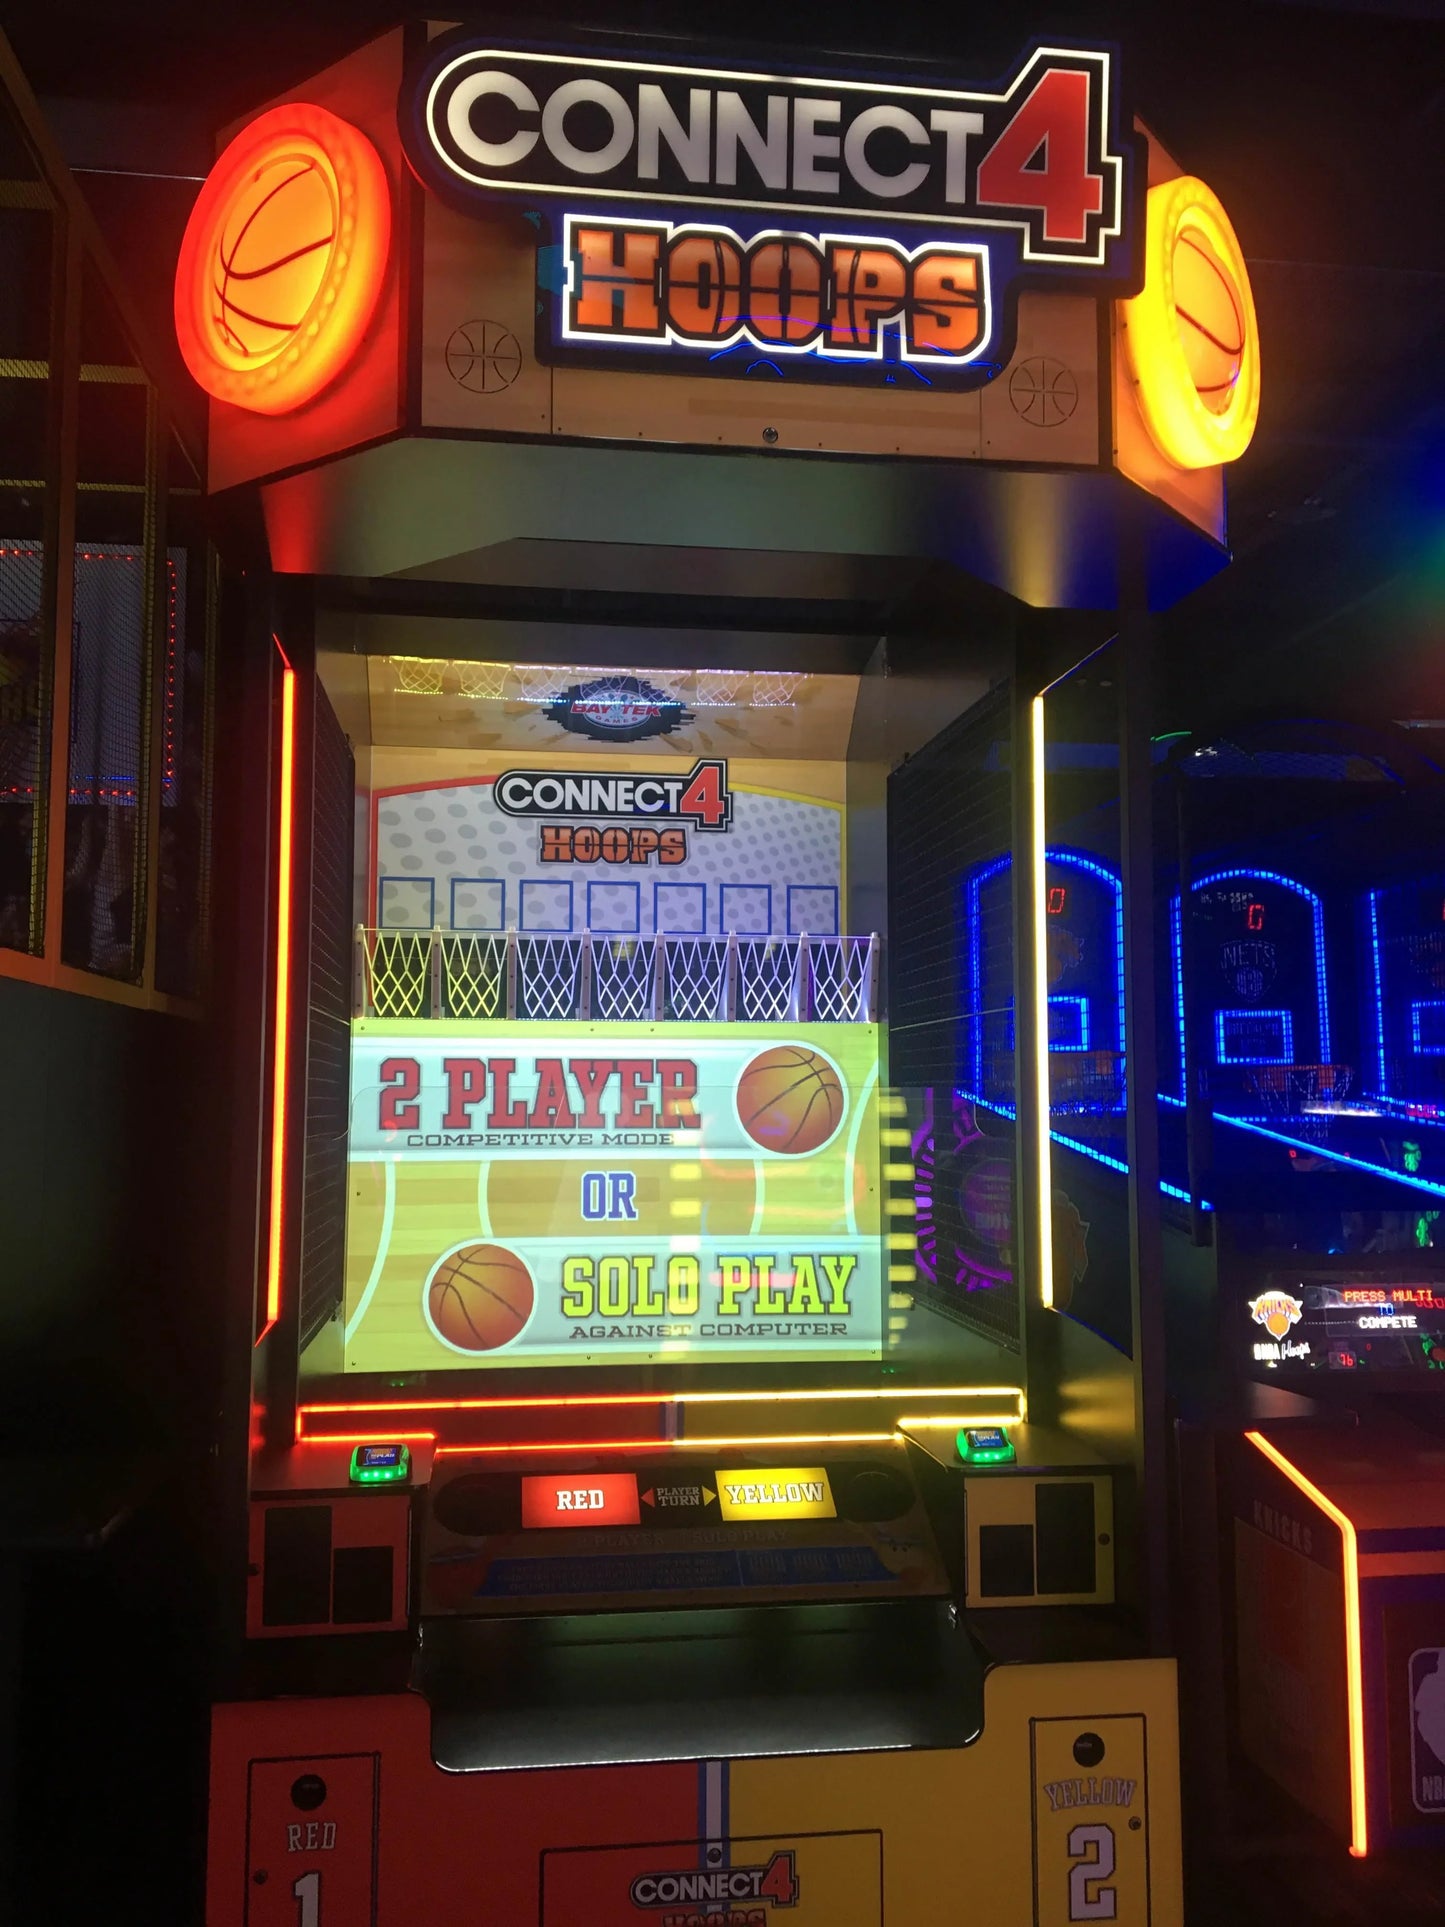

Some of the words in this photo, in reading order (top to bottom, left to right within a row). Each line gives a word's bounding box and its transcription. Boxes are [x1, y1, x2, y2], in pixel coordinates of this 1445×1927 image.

[446, 70, 984, 204] CONNECT
[976, 68, 1103, 244] 4
[570, 224, 987, 357] HOOPS
[570, 701, 612, 714] BAY
[620, 702, 662, 717] TEK
[595, 715, 639, 724] GAMES
[501, 776, 683, 813] CONNECT
[680, 766, 726, 825] 4
[539, 825, 689, 866] HOOPS
[377, 1056, 421, 1131] 2
[441, 1056, 703, 1131] PLAYER
[406, 1133, 593, 1148] COMPETITIVE
[602, 1132, 676, 1147] MODE
[580, 1170, 639, 1221] OR
[560, 1253, 702, 1320] SOLO
[716, 1253, 859, 1317] PLAY
[1343, 1290, 1386, 1303] PRESS
[1392, 1289, 1433, 1302] MULTI
[568, 1323, 693, 1340] AGAINST
[699, 1321, 849, 1338] COMPUTER
[1358, 1315, 1418, 1329] COMPETE
[556, 1489, 605, 1512] RED
[656, 1486, 701, 1496] PLAYER
[657, 1494, 701, 1507] TURN
[722, 1481, 826, 1507] YELLOW
[1253, 1499, 1313, 1556] KNICKS
[1043, 1777, 1137, 1812] YELLOW
[1421, 1775, 1445, 1803] NB
[286, 1821, 337, 1853] RED
[634, 1871, 764, 1904] CONNECT
[760, 1855, 795, 1904] 4
[1066, 1821, 1118, 1923] 2
[293, 1870, 321, 1927] 1
